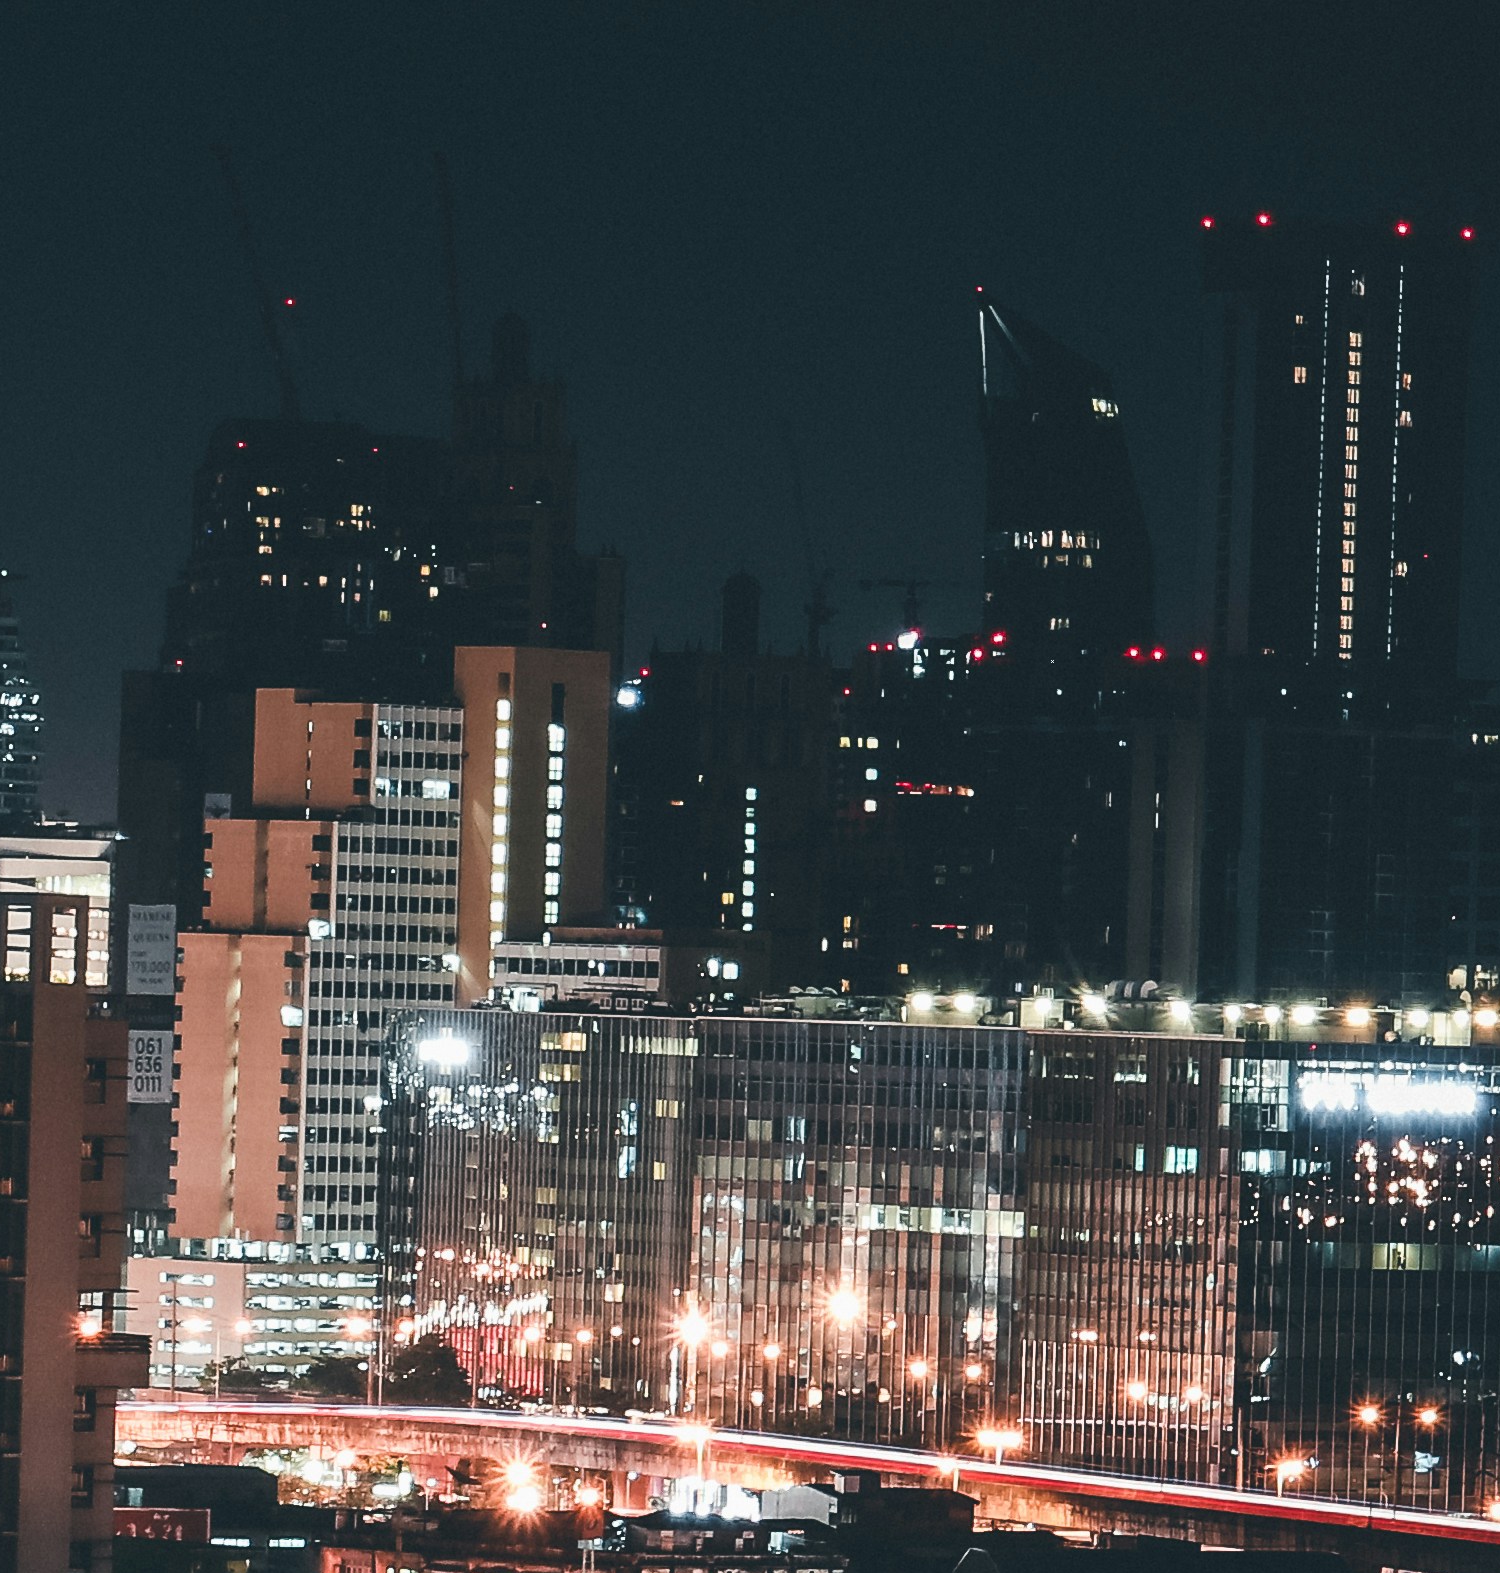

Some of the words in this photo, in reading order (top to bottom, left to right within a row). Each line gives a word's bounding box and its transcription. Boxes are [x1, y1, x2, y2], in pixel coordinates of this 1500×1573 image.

[135, 1037, 162, 1054] 061
[135, 1056, 162, 1073] 636
[134, 1075, 162, 1092] 0111
